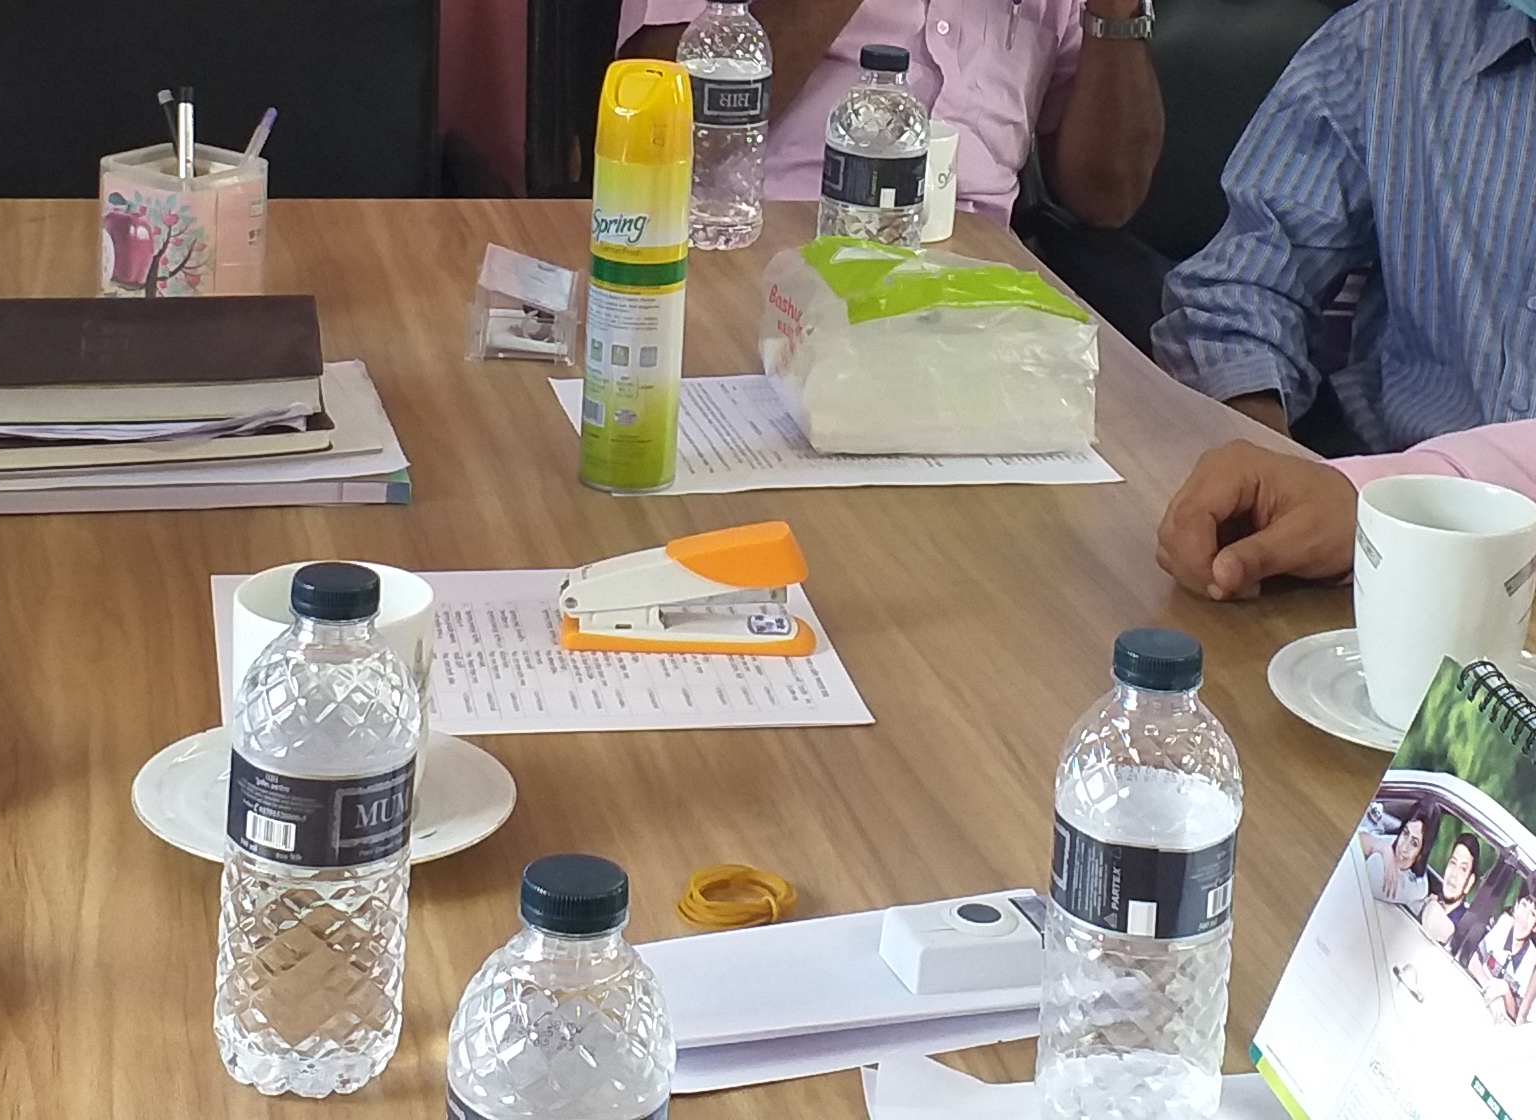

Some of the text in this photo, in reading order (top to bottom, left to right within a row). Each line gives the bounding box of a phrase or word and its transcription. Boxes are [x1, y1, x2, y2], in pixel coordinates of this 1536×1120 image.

[720, 93, 750, 108] মাম
[592, 208, 648, 244] Spring
[1111, 867, 1122, 911] PARTEX
